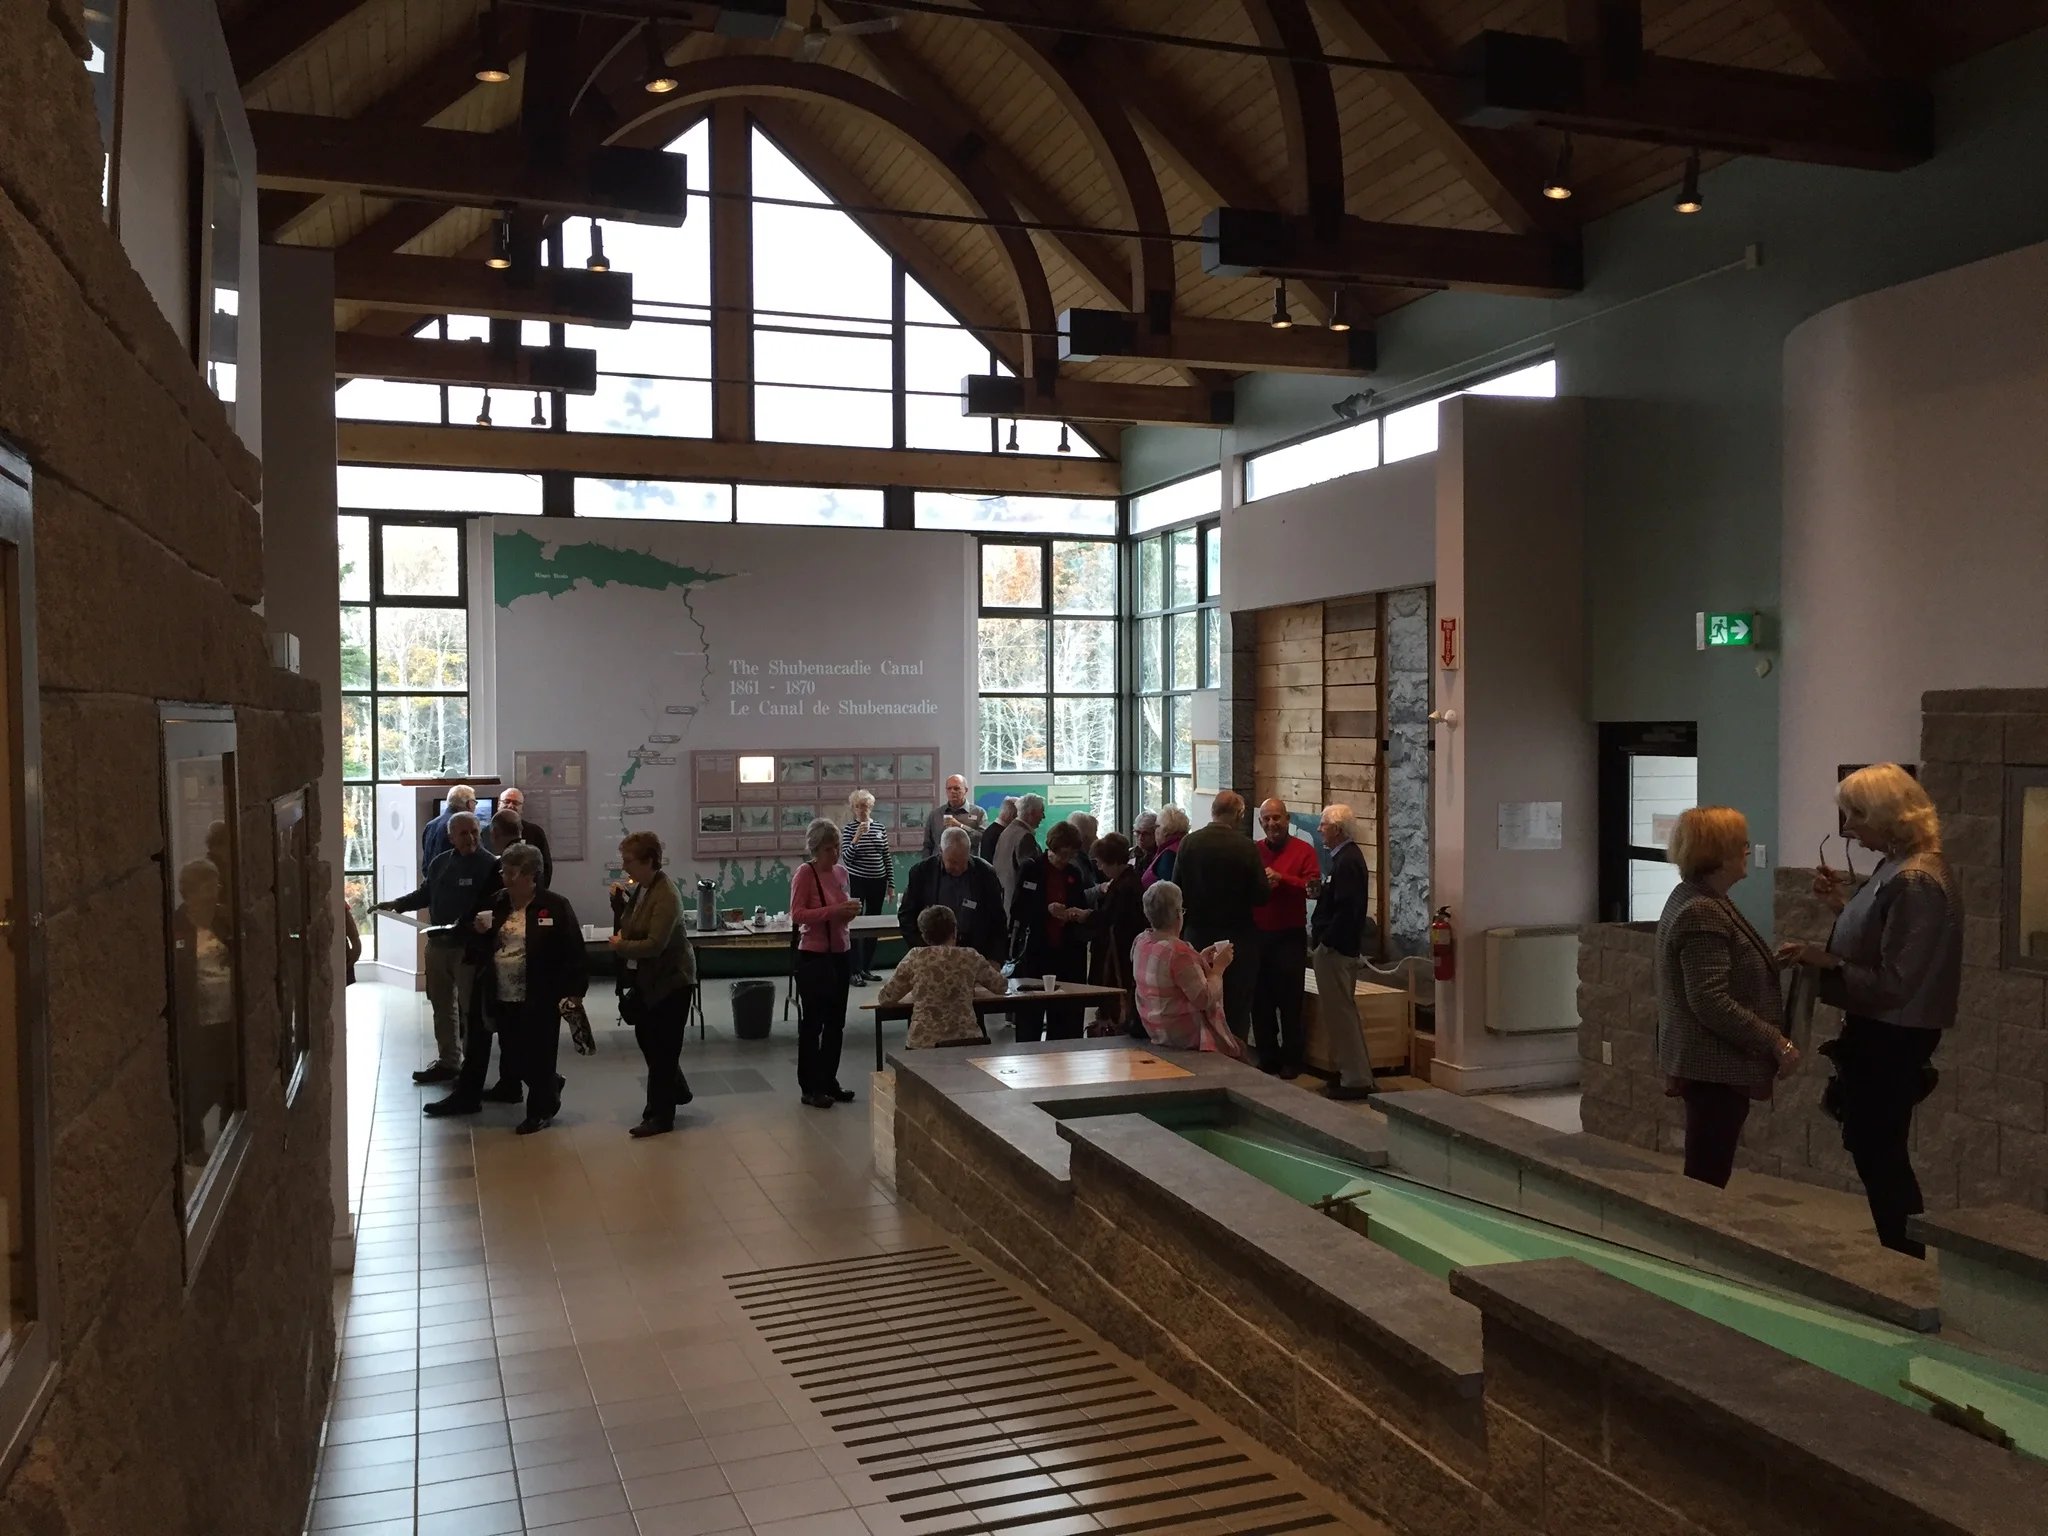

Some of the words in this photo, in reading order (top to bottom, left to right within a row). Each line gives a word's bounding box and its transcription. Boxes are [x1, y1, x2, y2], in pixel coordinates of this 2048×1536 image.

[729, 660, 759, 675] The
[768, 660, 871, 675] Shubenacadie
[881, 660, 924, 675] Canal
[730, 680, 760, 695] 1861
[786, 680, 815, 695] 1870
[730, 701, 750, 715] Le
[759, 700, 803, 715] Canal
[813, 700, 829, 715] de
[839, 699, 938, 715] Shubenacadie
